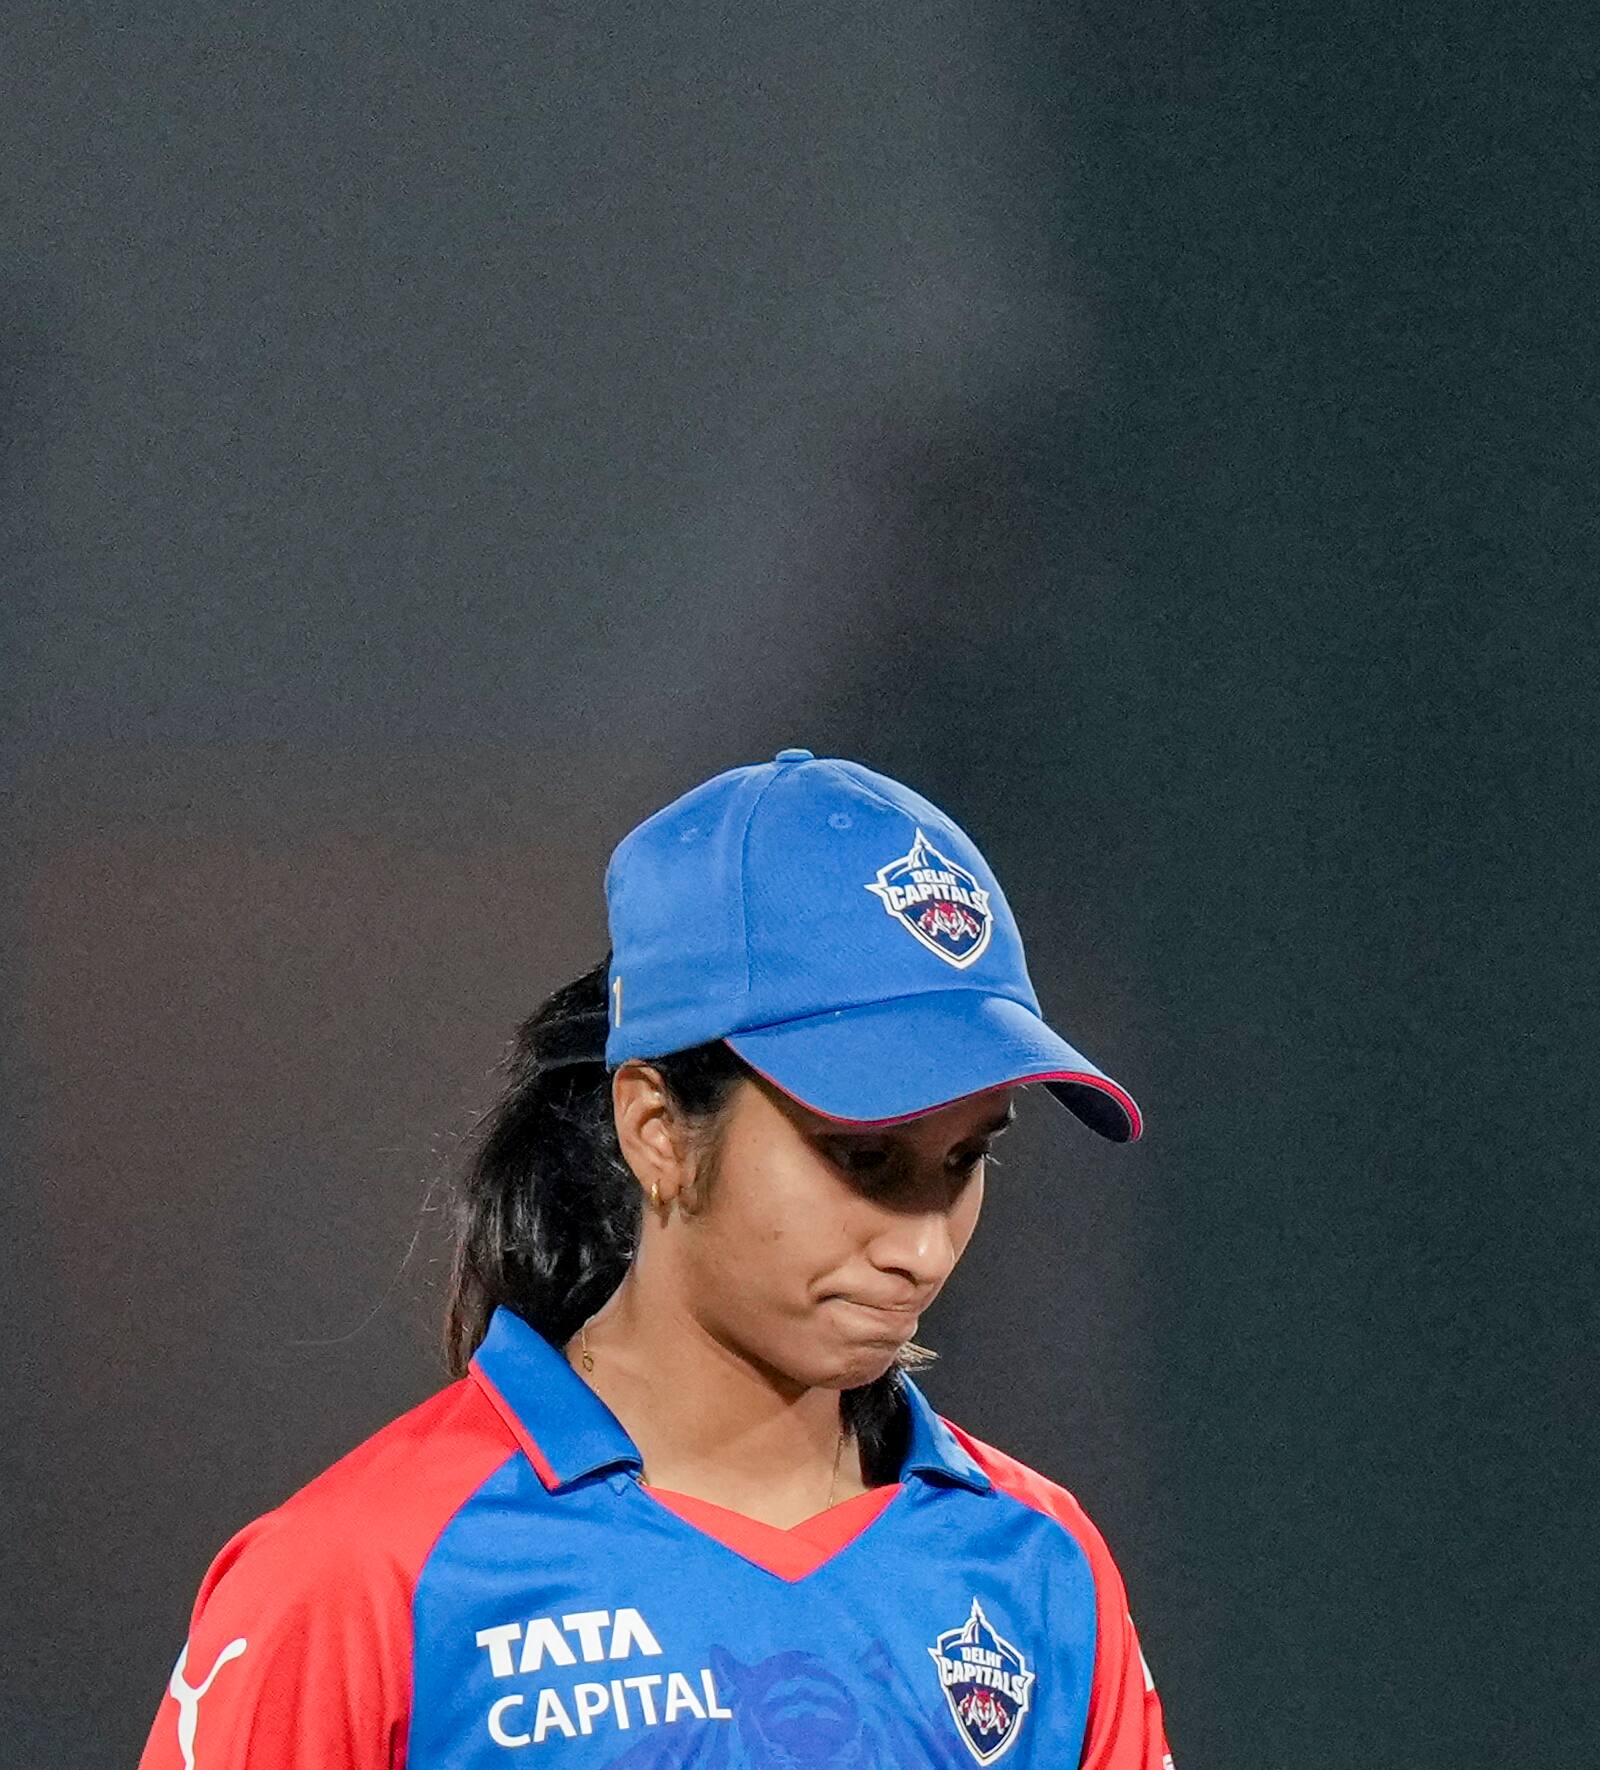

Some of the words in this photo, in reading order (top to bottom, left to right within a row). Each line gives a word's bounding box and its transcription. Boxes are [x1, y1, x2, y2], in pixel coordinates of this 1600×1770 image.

[910, 869, 956, 886] DELHI
[892, 884, 987, 913] CAPITALS
[475, 1608, 663, 1678] TATA
[960, 1647, 1002, 1668] DELHI
[939, 1657, 1026, 1704] CAPITALS
[487, 1669, 733, 1747] CAPITAL
